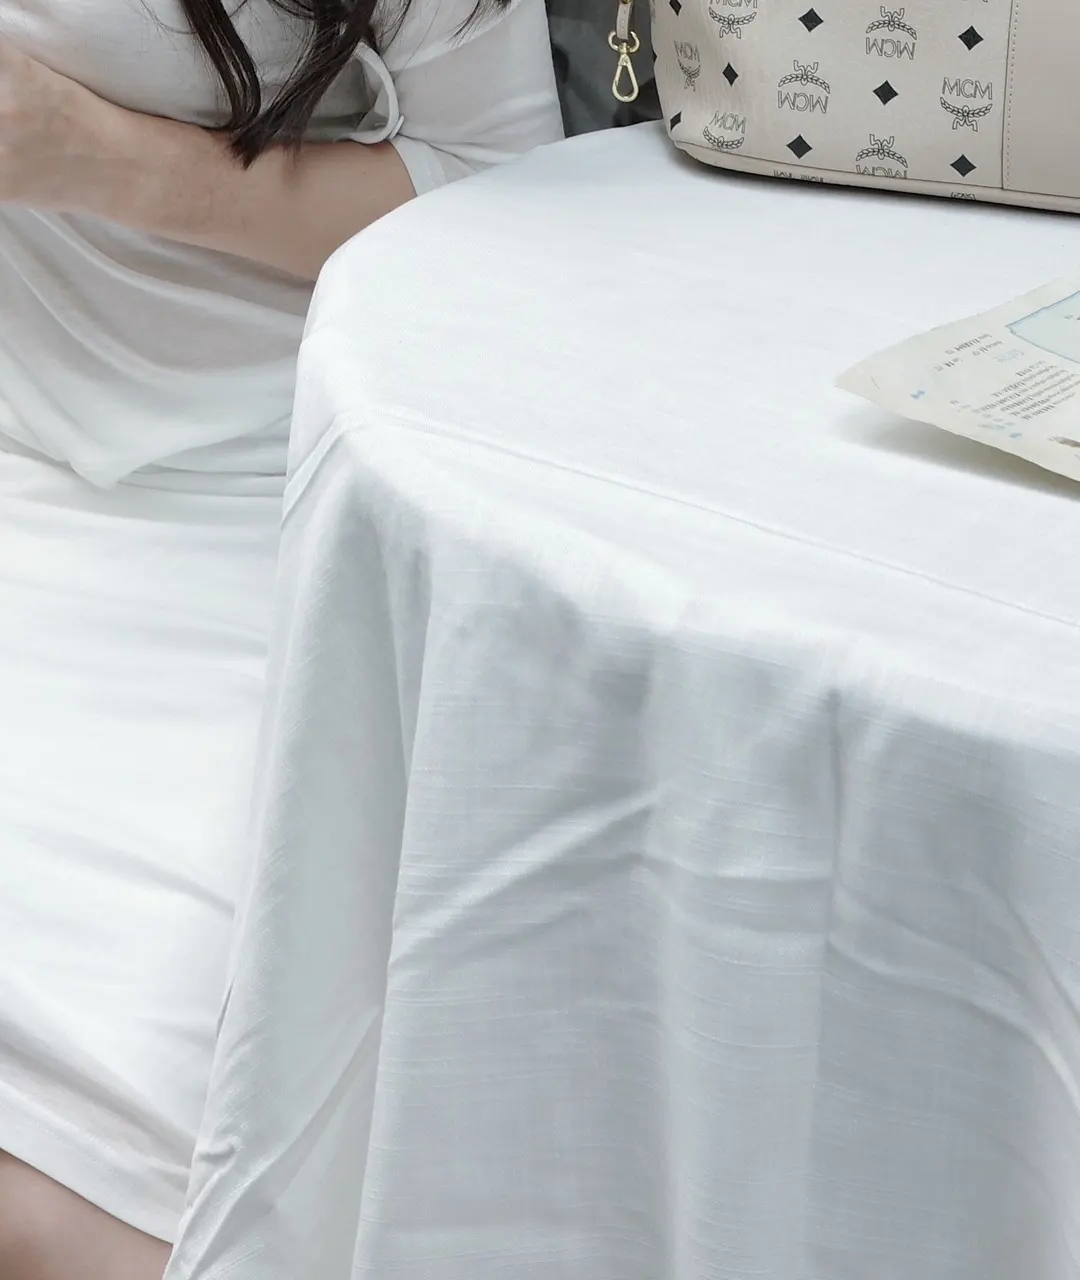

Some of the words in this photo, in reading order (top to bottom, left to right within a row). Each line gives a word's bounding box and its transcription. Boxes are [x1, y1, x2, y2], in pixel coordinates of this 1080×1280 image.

[674, 40, 701, 62] MCM
[865, 37, 916, 60] MCM
[941, 77, 993, 100] MCM
[777, 90, 829, 114] MCM
[709, 110, 747, 134] MCM
